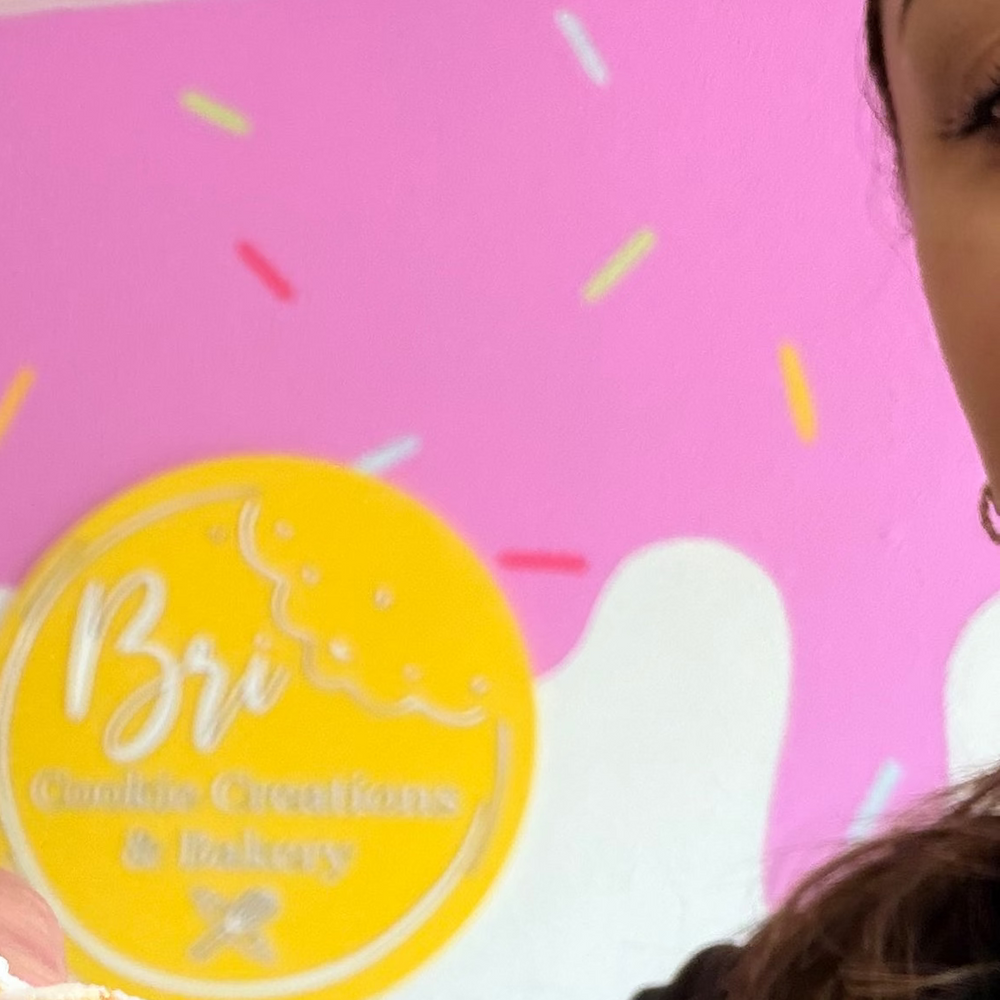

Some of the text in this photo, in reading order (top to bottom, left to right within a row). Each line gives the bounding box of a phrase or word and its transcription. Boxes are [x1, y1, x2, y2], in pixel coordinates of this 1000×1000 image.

[64, 566, 290, 764] Bri
[29, 766, 460, 816] Cookie Creations
[122, 827, 356, 887] & Bakery
